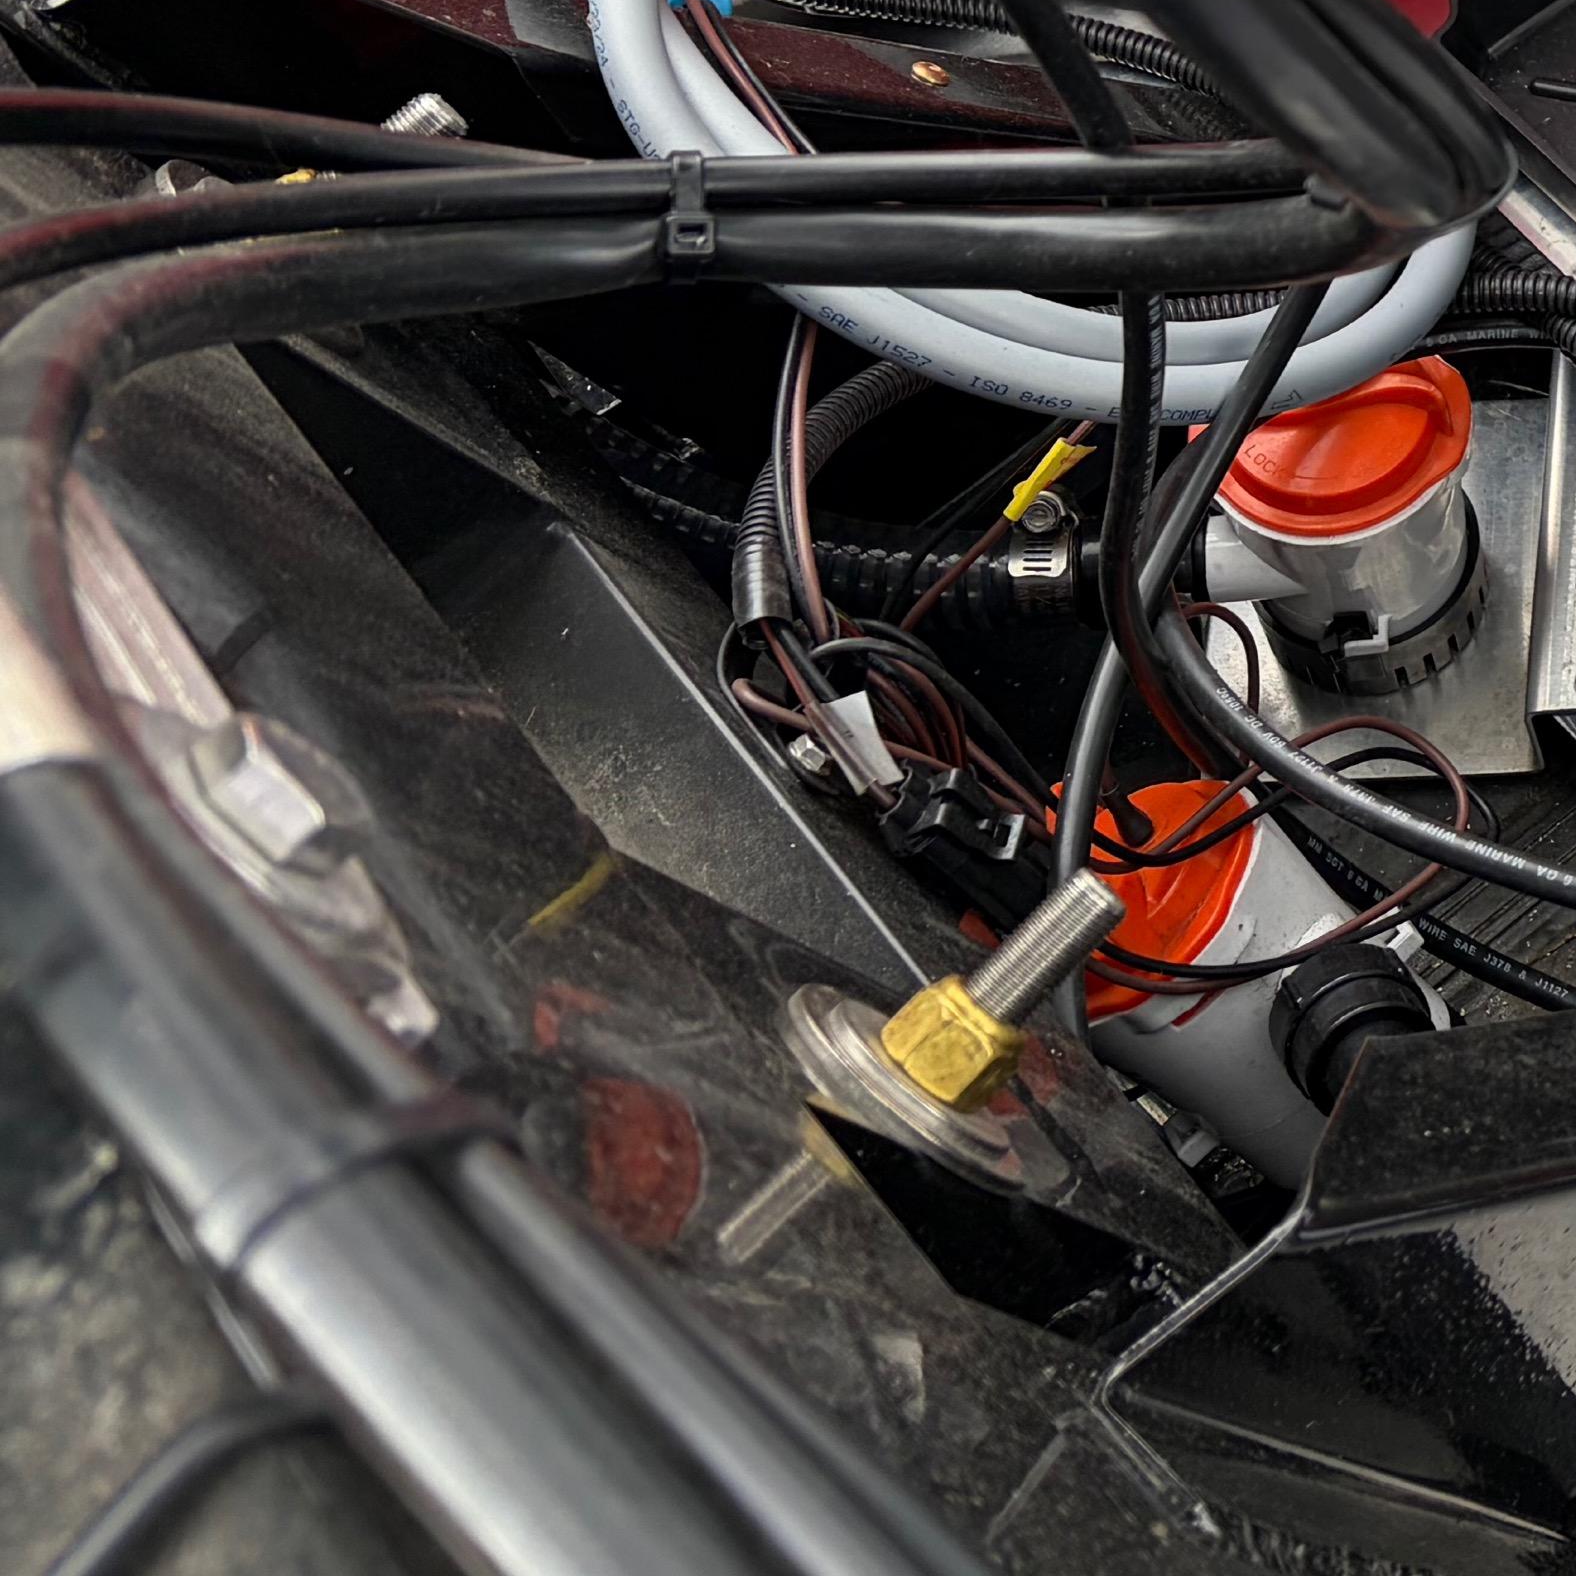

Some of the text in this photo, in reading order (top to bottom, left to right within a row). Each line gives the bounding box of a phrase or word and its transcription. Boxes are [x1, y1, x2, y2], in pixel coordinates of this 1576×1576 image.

[1466, 328, 1519, 339] MARINE
[818, 304, 859, 334] SAE
[866, 335, 933, 370] J1527
[968, 375, 1008, 397] ISO
[1019, 390, 1074, 411] 8469
[1244, 713, 1264, 730] DC
[1380, 804, 1414, 825] SAE
[1416, 821, 1459, 848] WIRE
[1306, 836, 1324, 857] MM
[1324, 850, 1346, 872] SGT
[1354, 873, 1369, 893] GA
[1463, 839, 1526, 870] MARINE
[1536, 865, 1559, 881] GA
[1562, 875, 1574, 888] 6
[1418, 917, 1448, 941] WIRE
[1453, 939, 1478, 956] SAE
[1483, 954, 1513, 973] J378
[1535, 978, 1569, 998] J1127
